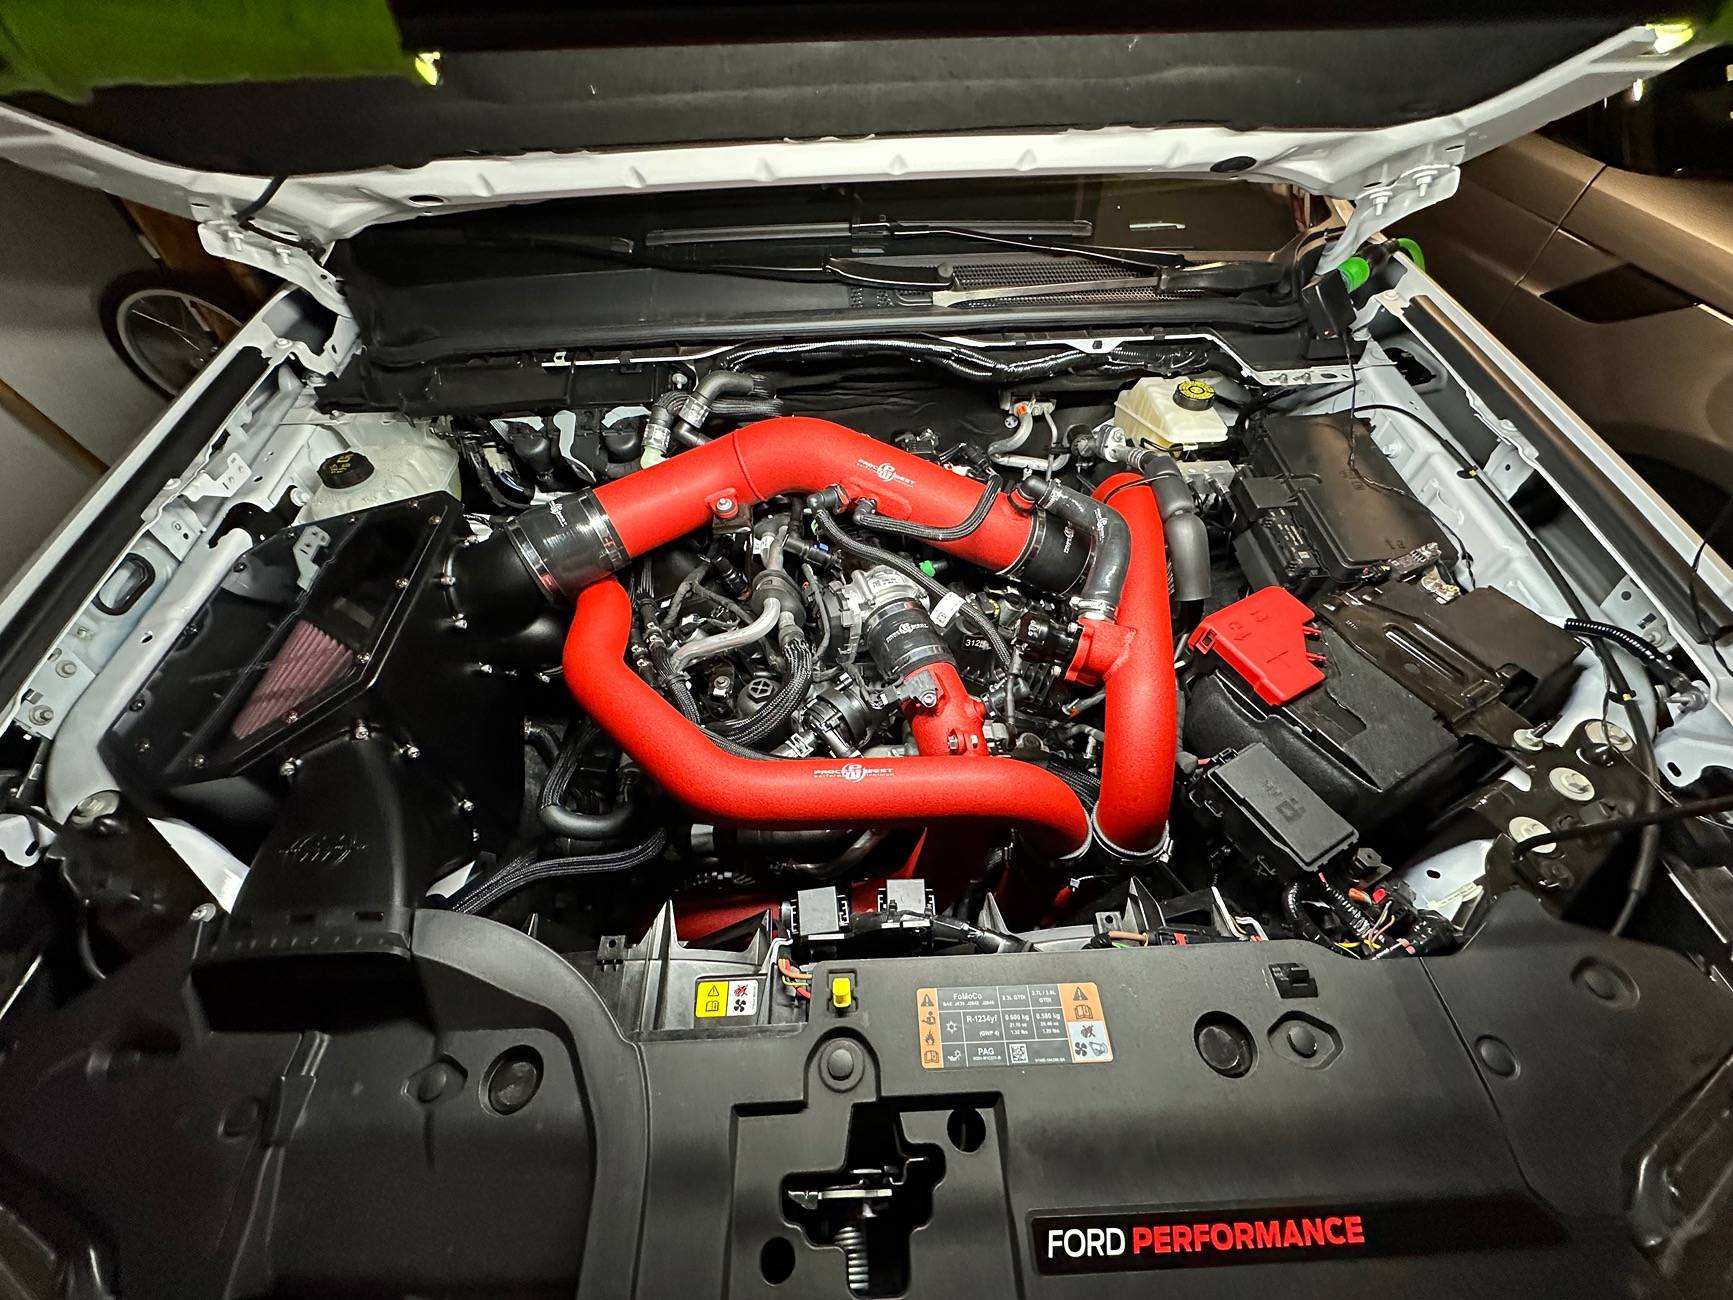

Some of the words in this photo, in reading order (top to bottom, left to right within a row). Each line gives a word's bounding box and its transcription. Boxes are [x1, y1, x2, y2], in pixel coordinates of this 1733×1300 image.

[953, 992, 983, 1001] FoMoCo
[966, 1014, 998, 1024] R-1234yf
[977, 1047, 995, 1056] PAG
[1047, 1227, 1126, 1258] FORD
[1132, 1215, 1365, 1255] PERFORMANCE
